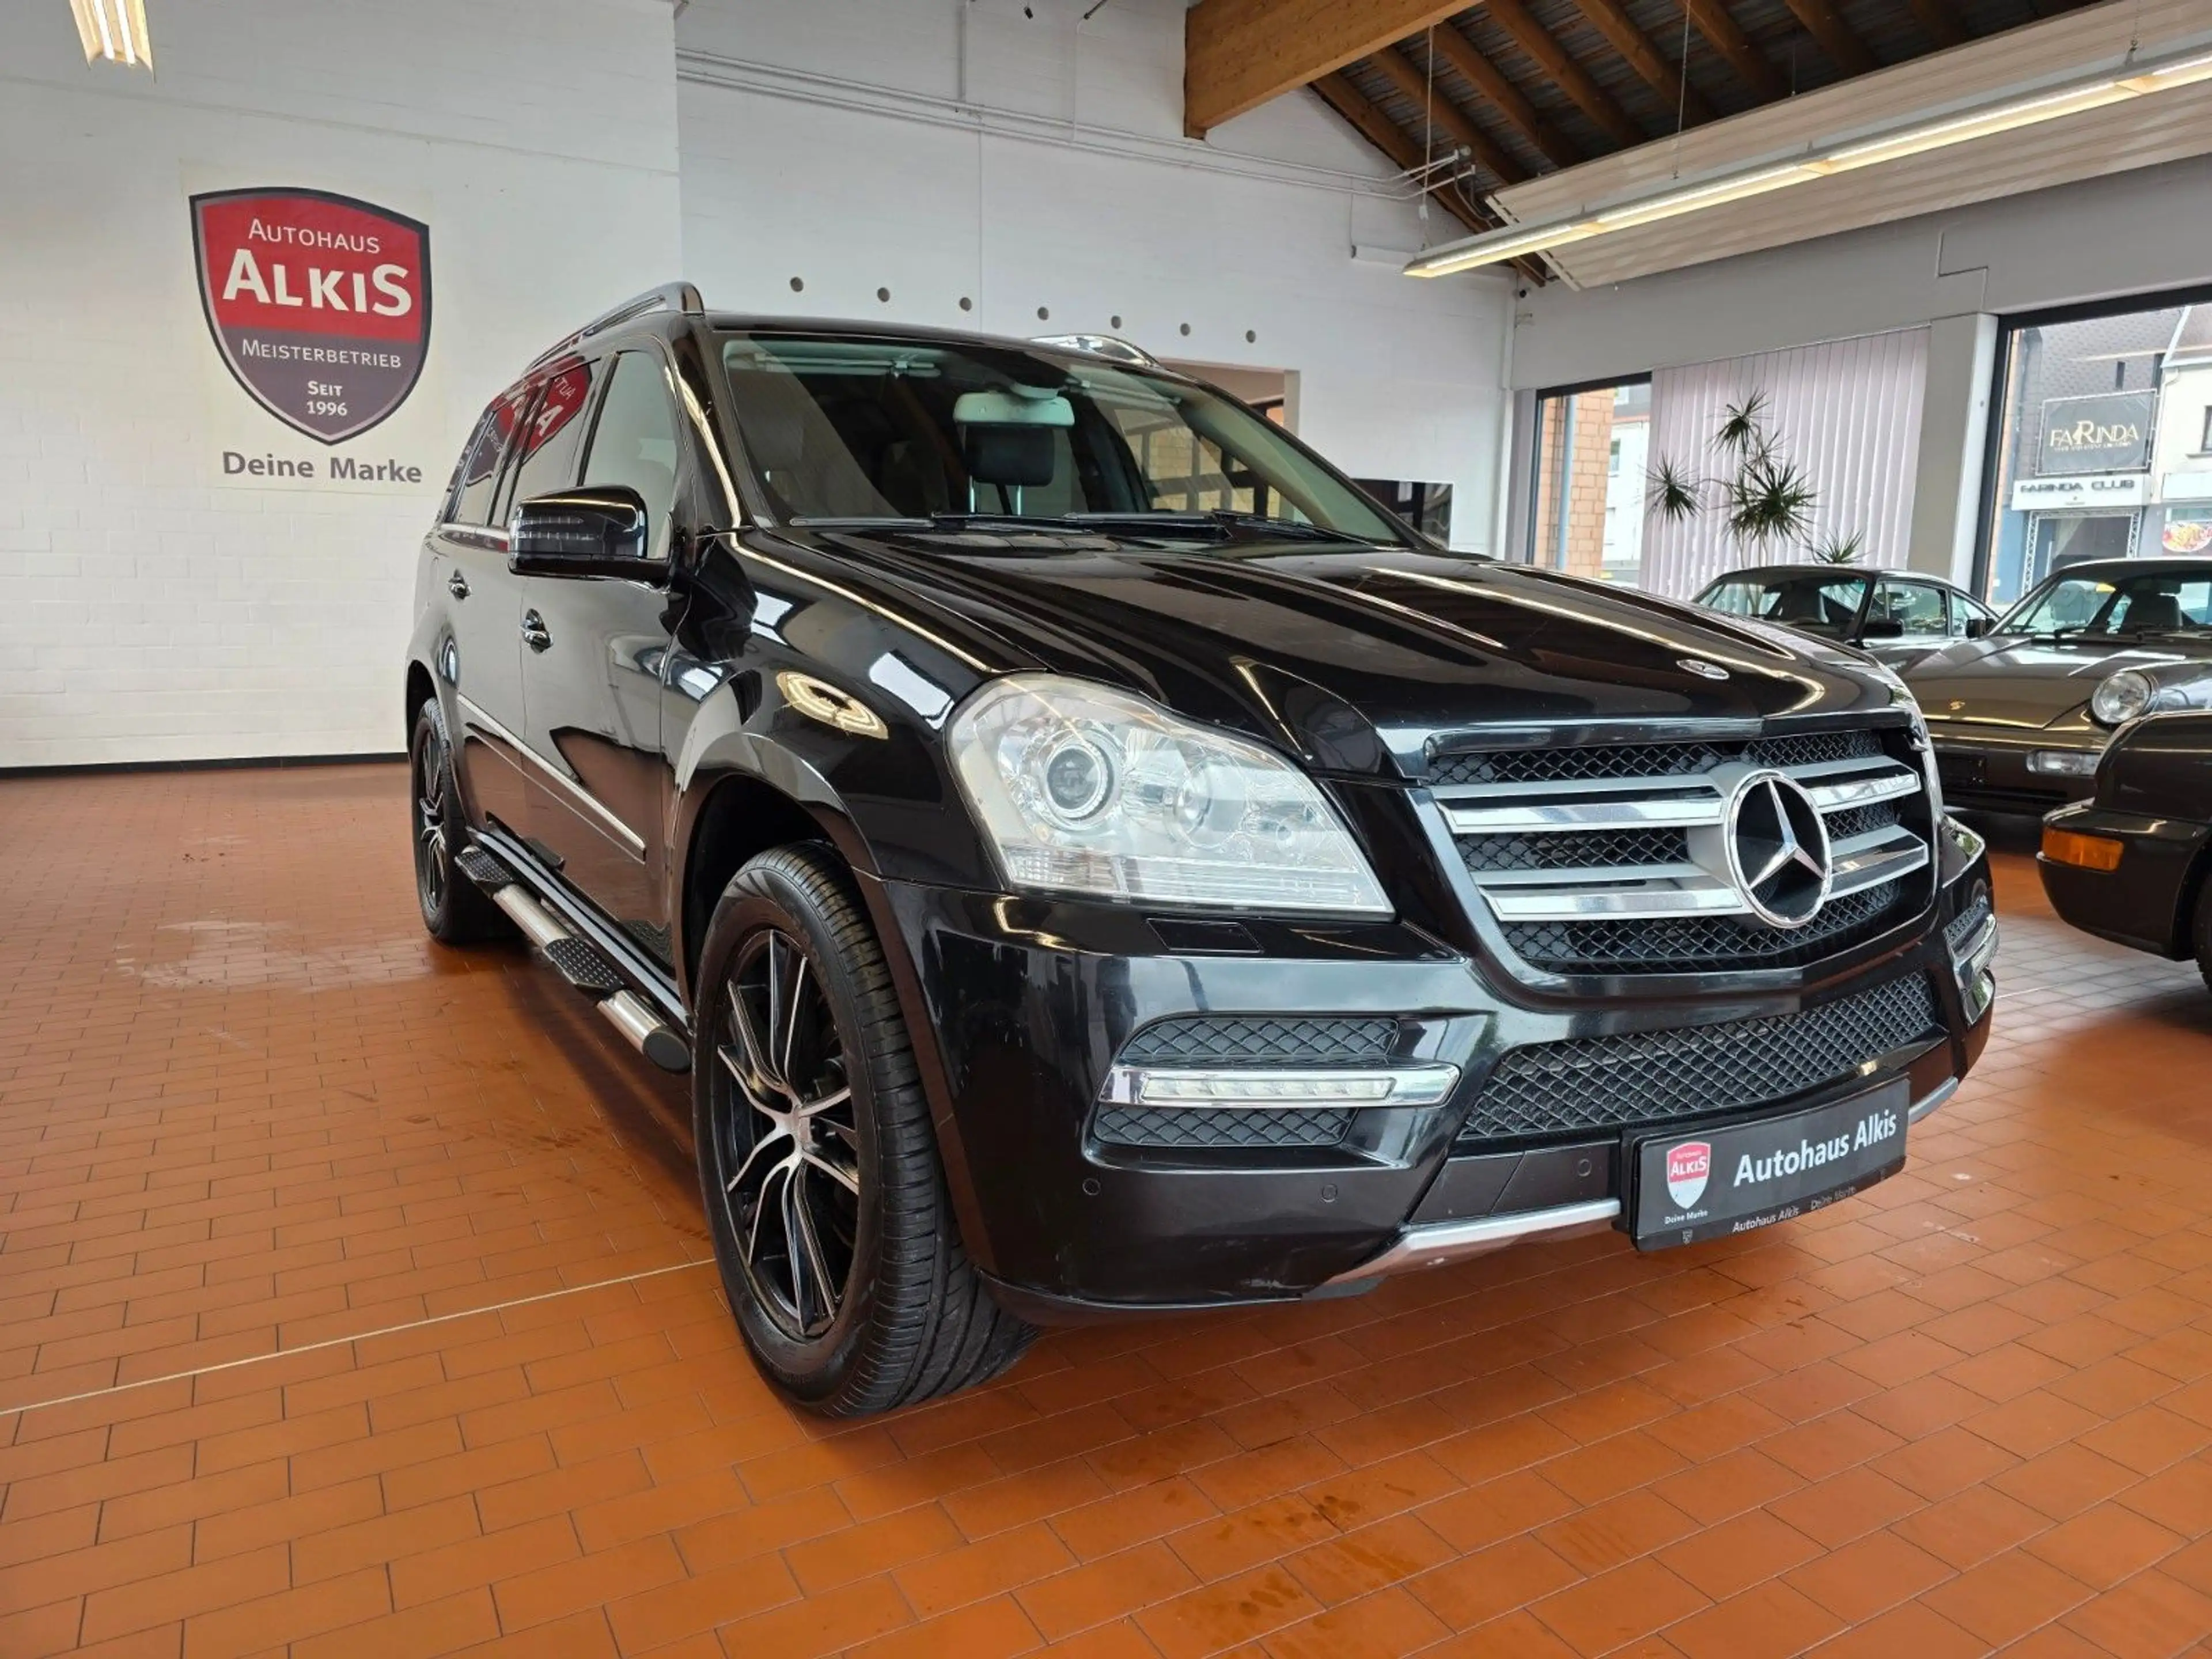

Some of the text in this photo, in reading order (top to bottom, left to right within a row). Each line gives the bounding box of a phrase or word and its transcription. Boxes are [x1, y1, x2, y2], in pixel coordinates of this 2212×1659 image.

[222, 248, 412, 317] ALKIS
[306, 401, 347, 416] 1996
[223, 452, 422, 483] Deine Marke
[2091, 479, 2135, 491] CLUB
[1733, 1108, 1897, 1187] Autohaus Alkis
[1671, 1156, 1707, 1177] ALKIS
[1732, 1214, 1777, 1233] Autohaus
